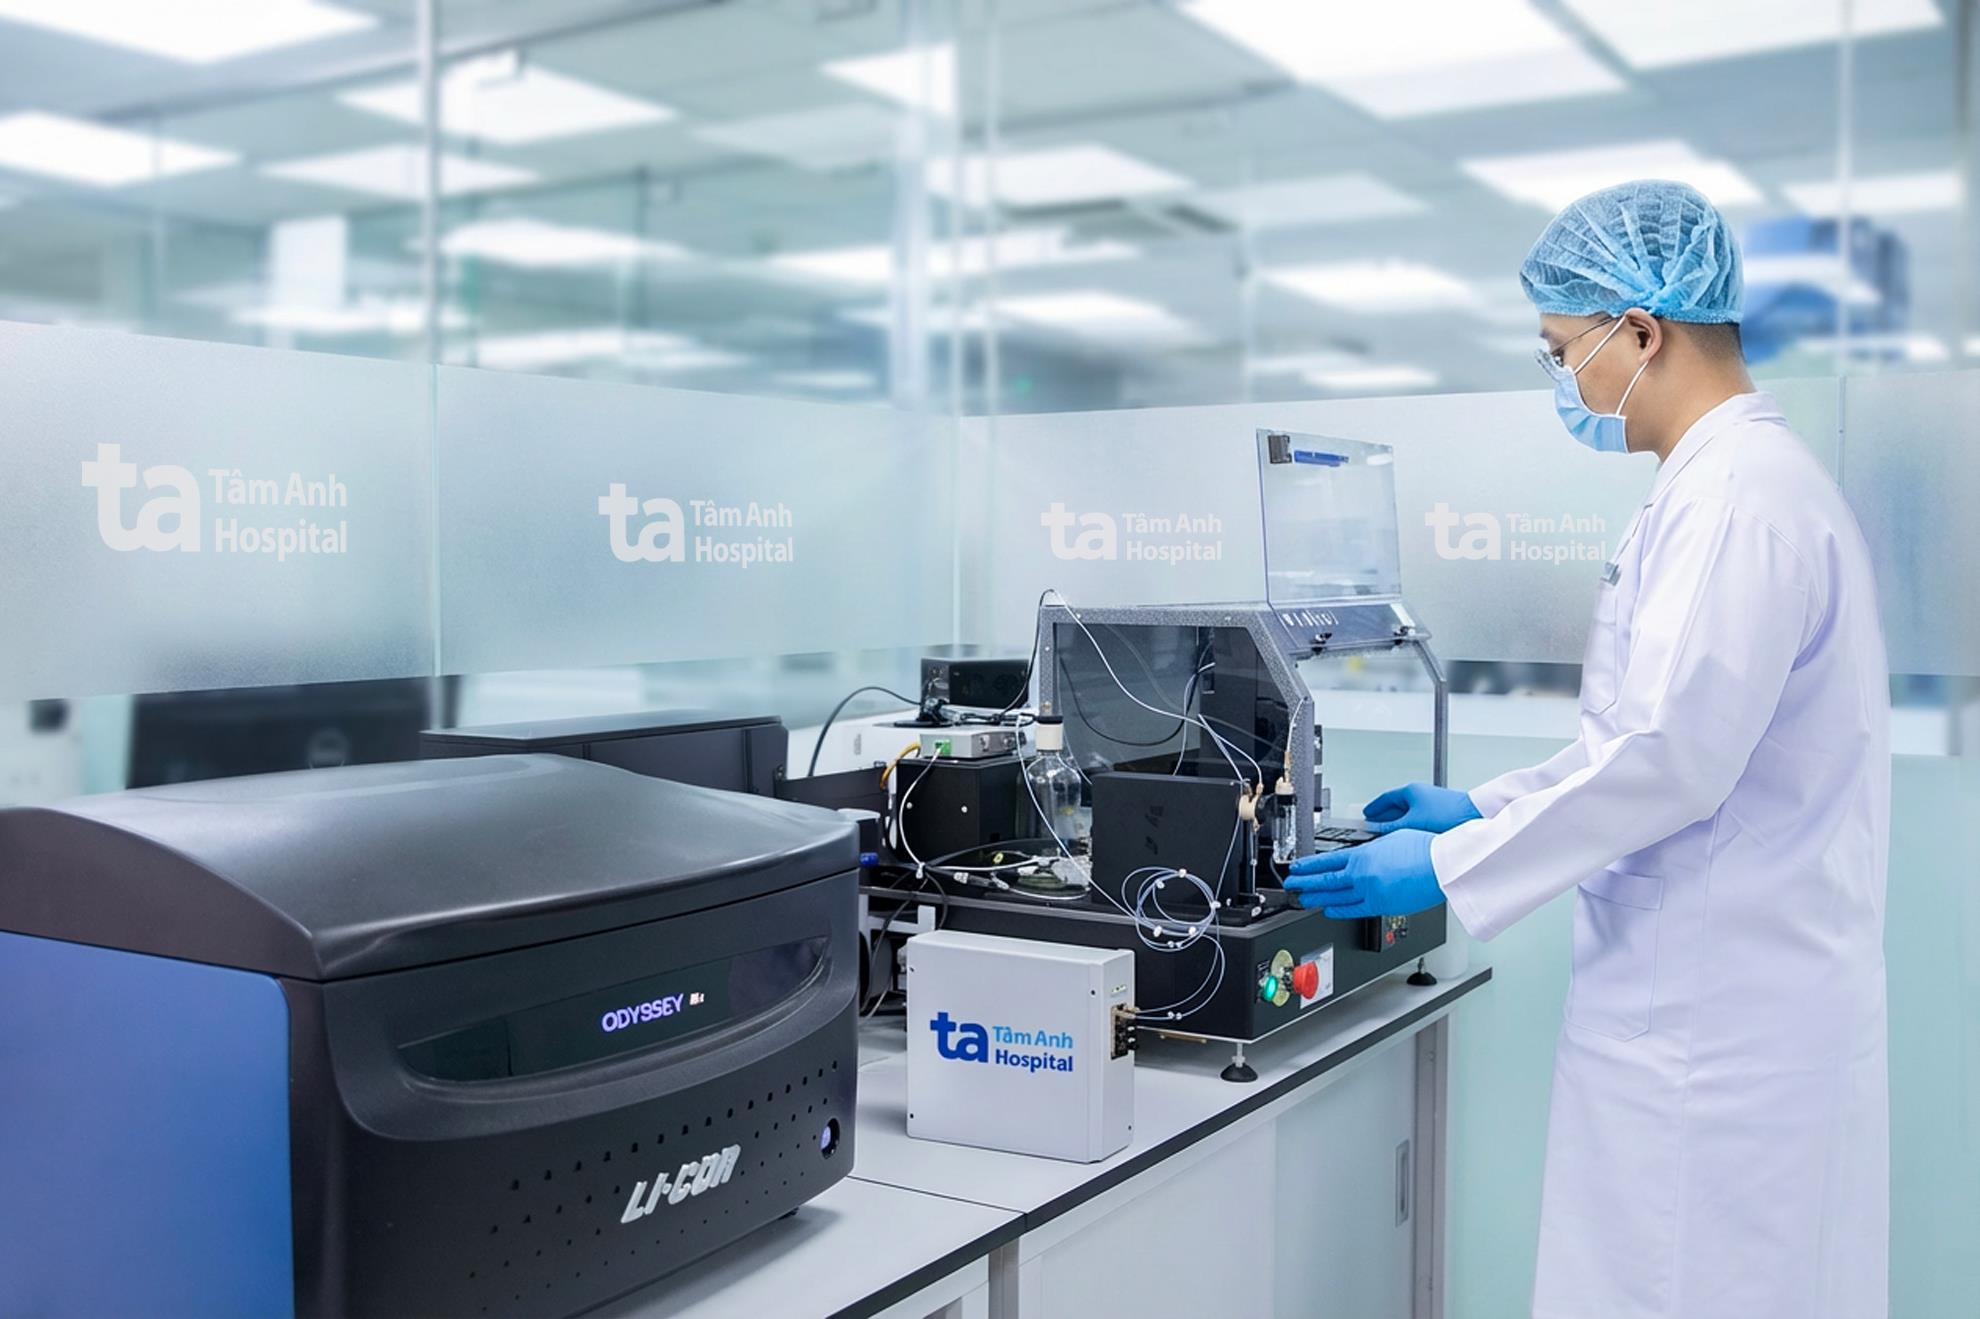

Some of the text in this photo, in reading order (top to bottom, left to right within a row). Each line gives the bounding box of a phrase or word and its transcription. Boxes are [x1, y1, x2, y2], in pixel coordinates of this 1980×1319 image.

[81, 442, 201, 552] ta
[207, 467, 348, 507] Tâm Anh
[598, 483, 685, 562] ta
[689, 499, 793, 528] Tâm Anh
[1040, 502, 1118, 561] ta
[1122, 512, 1222, 533] Tâm Anh
[1424, 502, 1501, 561] ta
[1505, 512, 1606, 533] Tâm Anh
[215, 517, 348, 562] Hospital
[695, 536, 794, 569] Hospital
[1125, 540, 1222, 566] Hospital
[1510, 540, 1606, 566] Hospital
[601, 993, 684, 1032] ODYSSEY
[929, 1011, 989, 1063] ta
[1034, 1029, 1073, 1049] Anh
[995, 1048, 1073, 1073] Hospital
